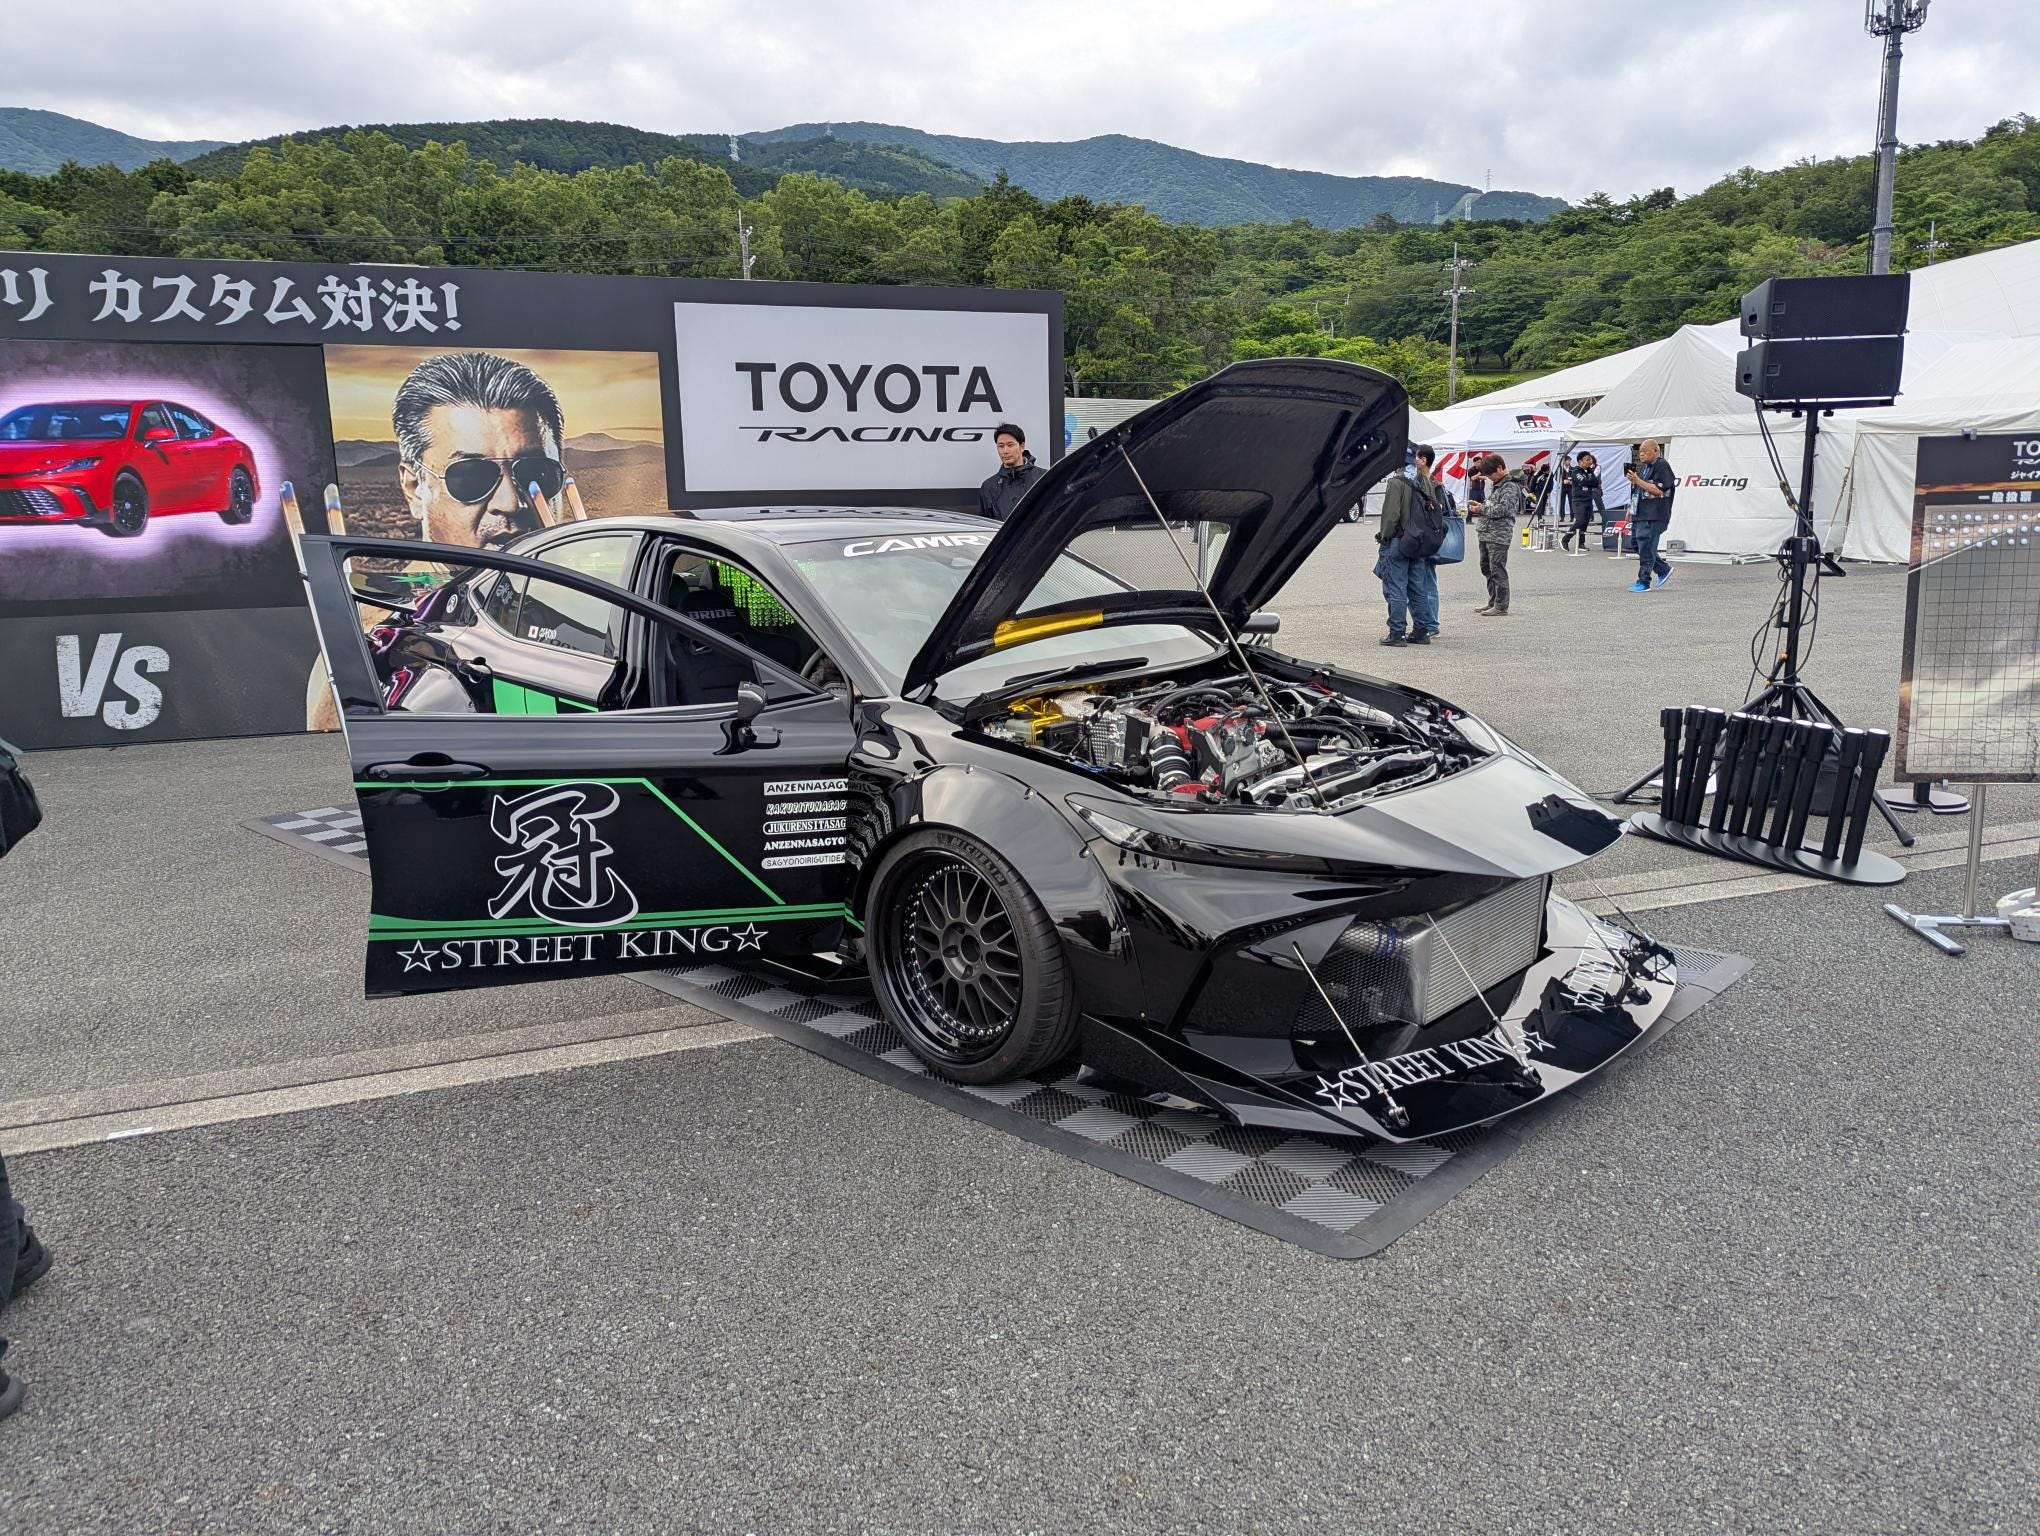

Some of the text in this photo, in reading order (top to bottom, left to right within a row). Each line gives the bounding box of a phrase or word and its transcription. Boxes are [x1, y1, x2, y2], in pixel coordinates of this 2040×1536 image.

[89, 268, 463, 333] カスタム対決!
[735, 361, 1004, 414] TOYOTA
[738, 425, 996, 443] RACING
[1684, 474, 1749, 491] Racing
[488, 781, 640, 928] 冠
[763, 836, 847, 851] ANZENNASAGYO
[949, 835, 1009, 888] MICHELIN
[440, 926, 731, 970] STREET KING
[1338, 1047, 1456, 1101] STREET
